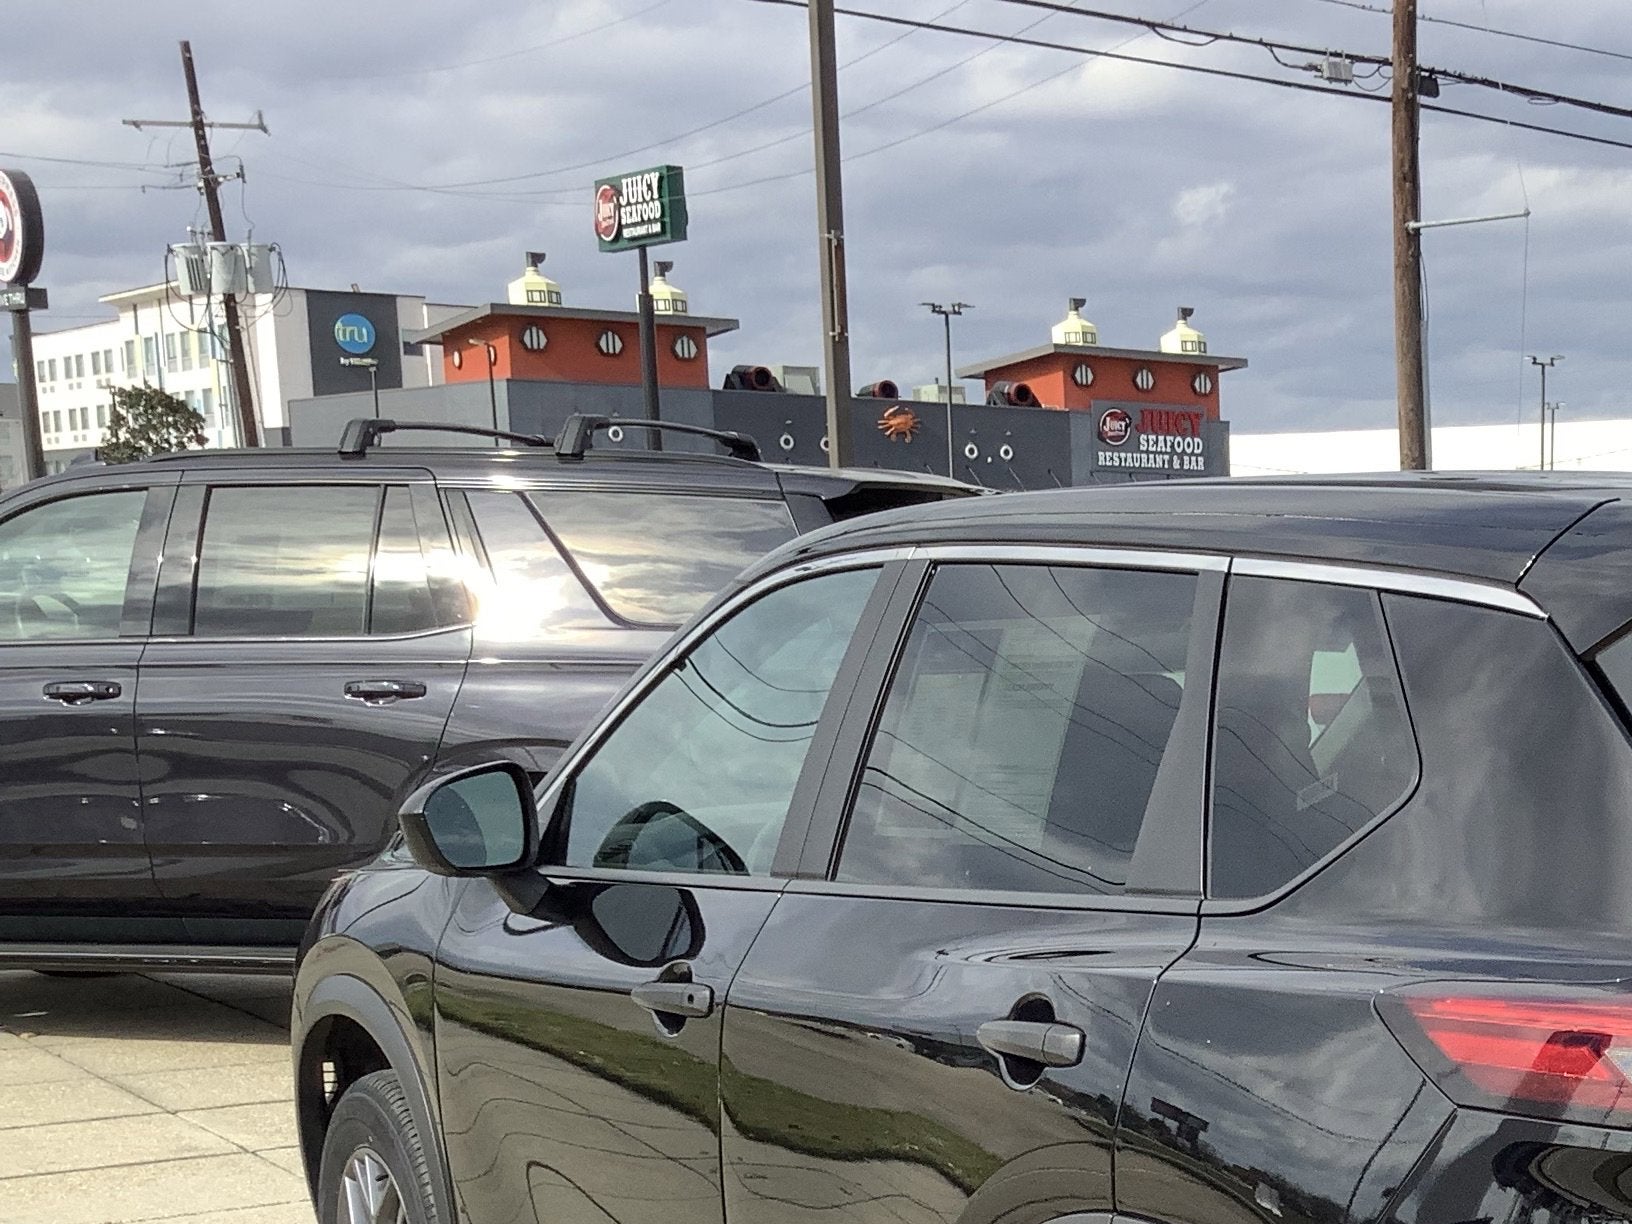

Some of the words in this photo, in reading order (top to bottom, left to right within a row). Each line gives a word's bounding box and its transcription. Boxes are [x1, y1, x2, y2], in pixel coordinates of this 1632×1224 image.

[619, 171, 660, 206] JUICY
[620, 200, 662, 225] SEAFOOD
[336, 320, 368, 343] tru
[1135, 408, 1204, 438] JUICY
[1139, 433, 1204, 454] SEAFOOD
[1097, 451, 1170, 469] RESTAURANT
[1172, 454, 1181, 470] &
[1182, 455, 1205, 471] BAR
